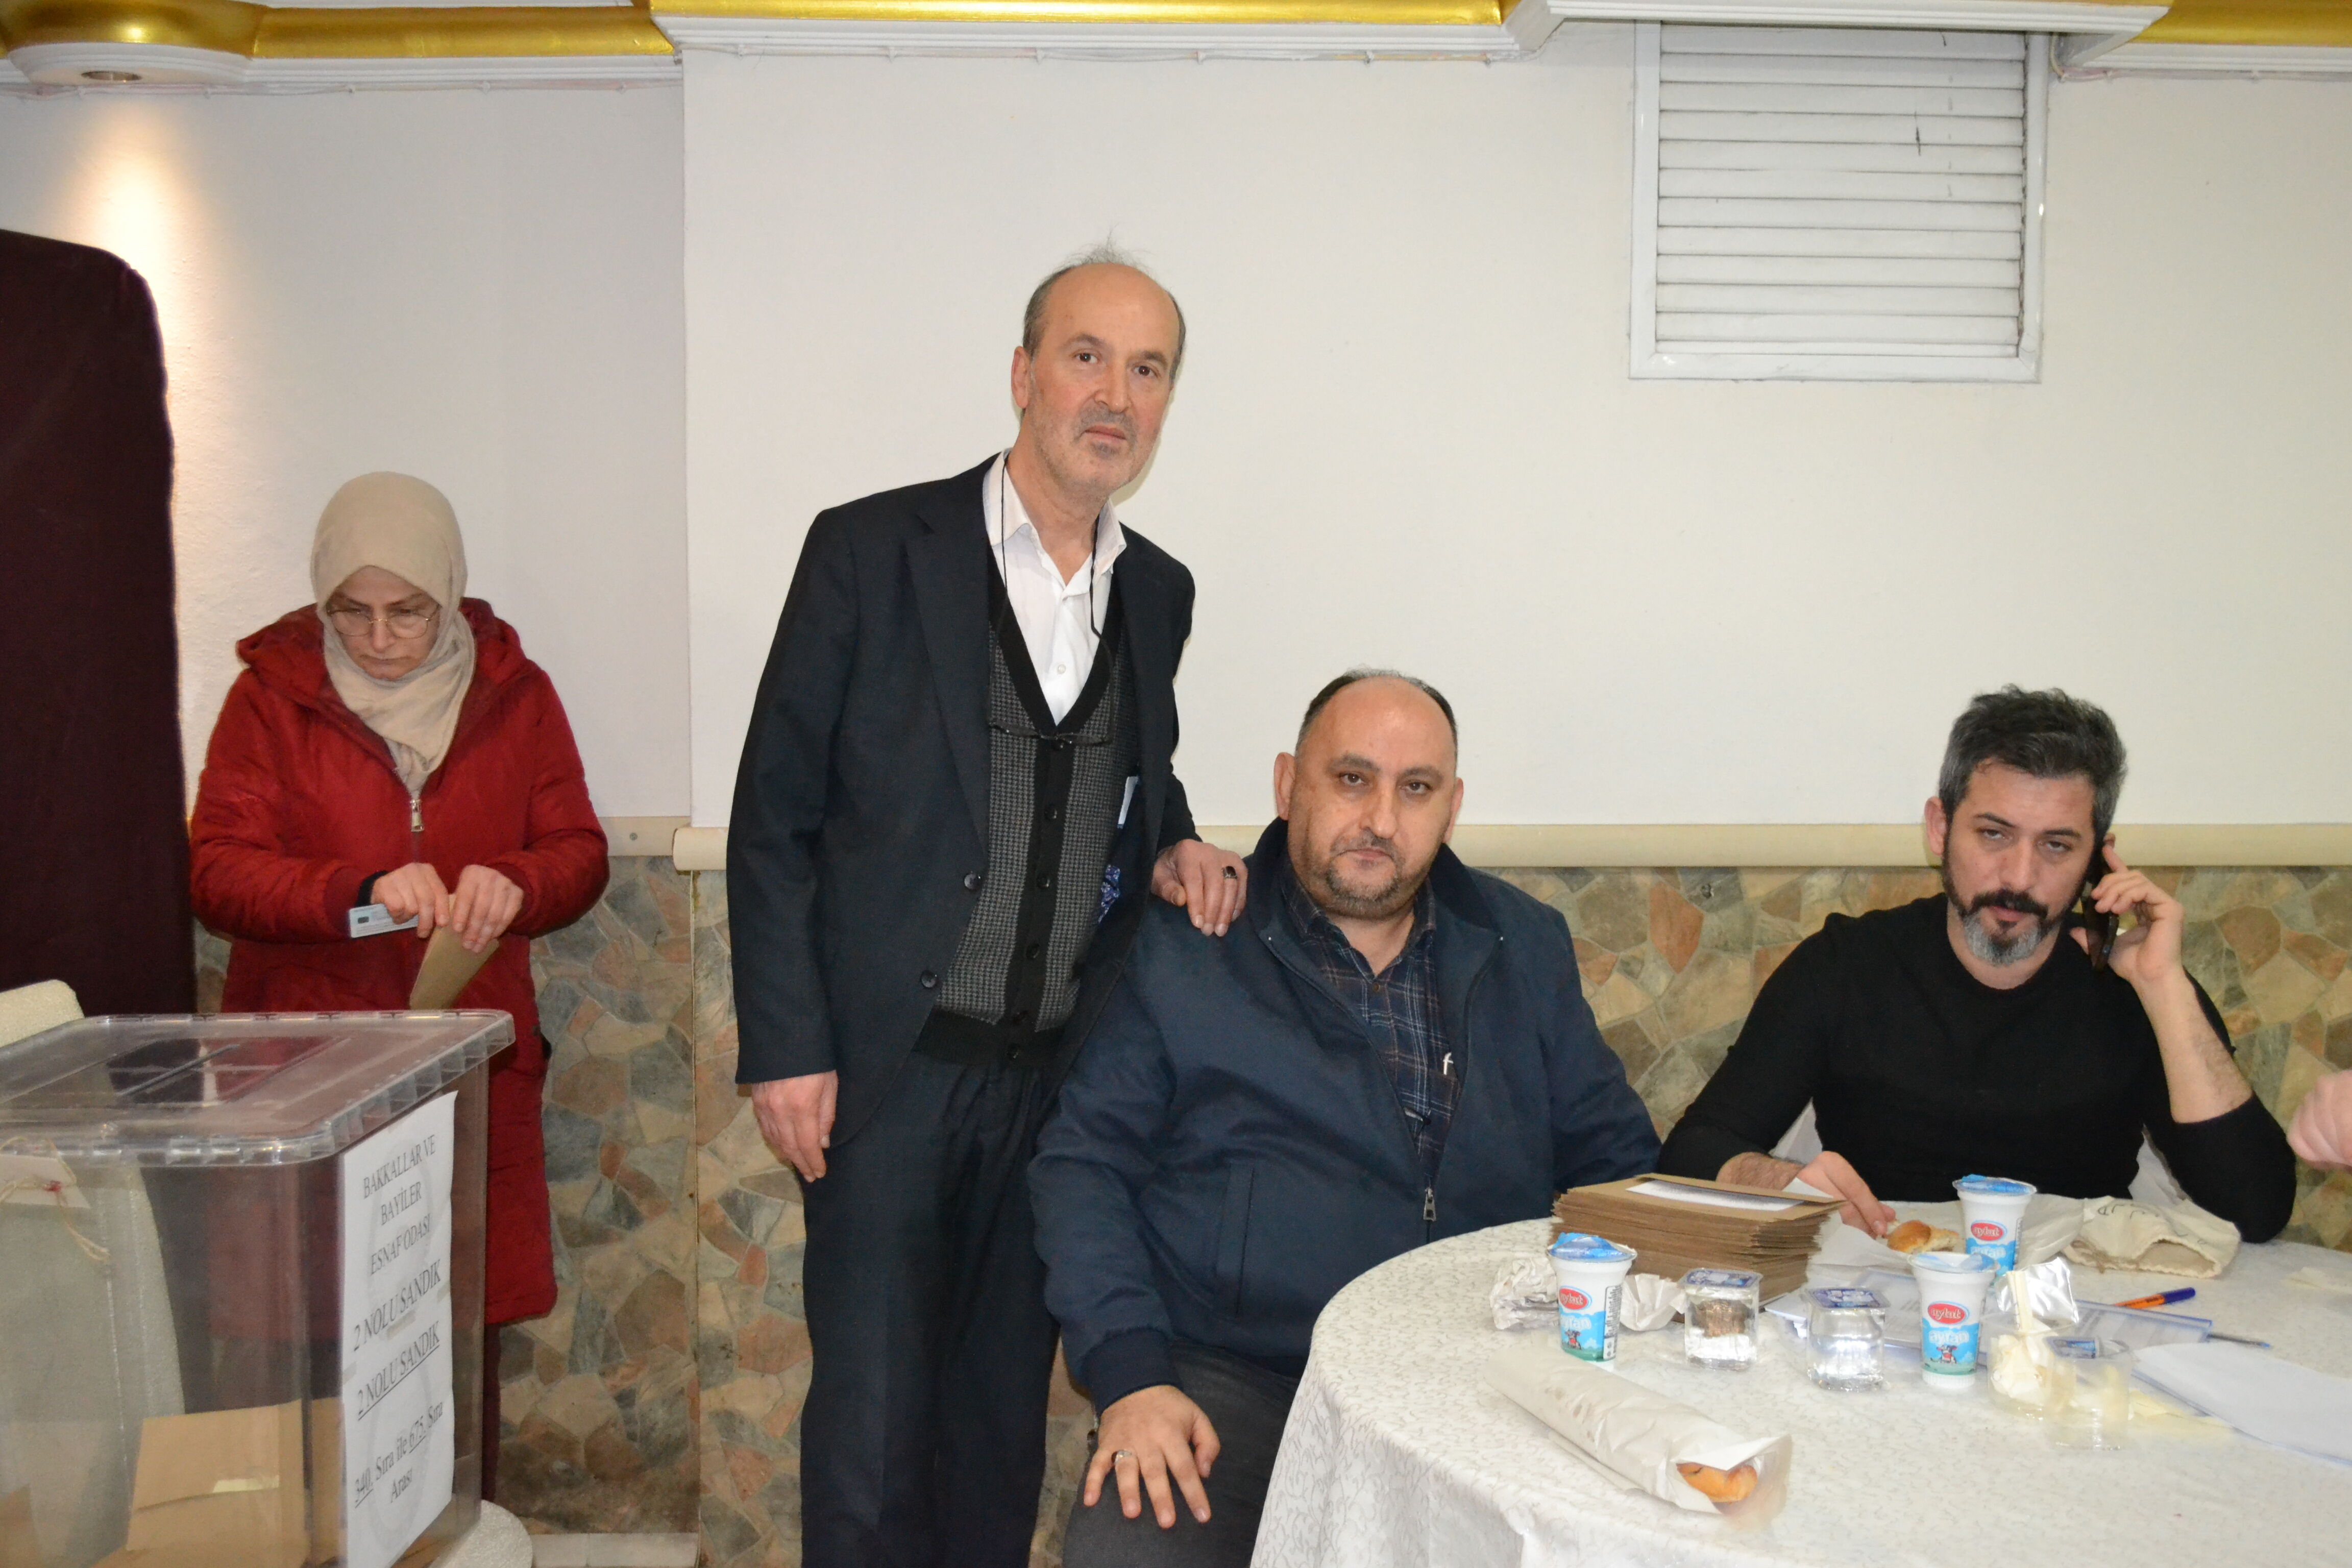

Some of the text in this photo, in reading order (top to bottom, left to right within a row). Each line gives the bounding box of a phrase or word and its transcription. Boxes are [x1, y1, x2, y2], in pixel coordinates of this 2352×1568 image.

[363, 1134, 436, 1199] BAKKALLAR VE
[381, 1181, 422, 1226] BAYİLER
[371, 1212, 431, 1275] ESNAF ODASI
[353, 1258, 441, 1352] 2 NOLU SANDIK
[358, 1319, 440, 1416] 2 NOLU SANDIK
[1929, 1330, 1969, 1346] ayran
[376, 1451, 395, 1481] Sıra
[396, 1436, 407, 1462] ile
[428, 1401, 444, 1429] Sıra
[390, 1466, 413, 1504] Arası
